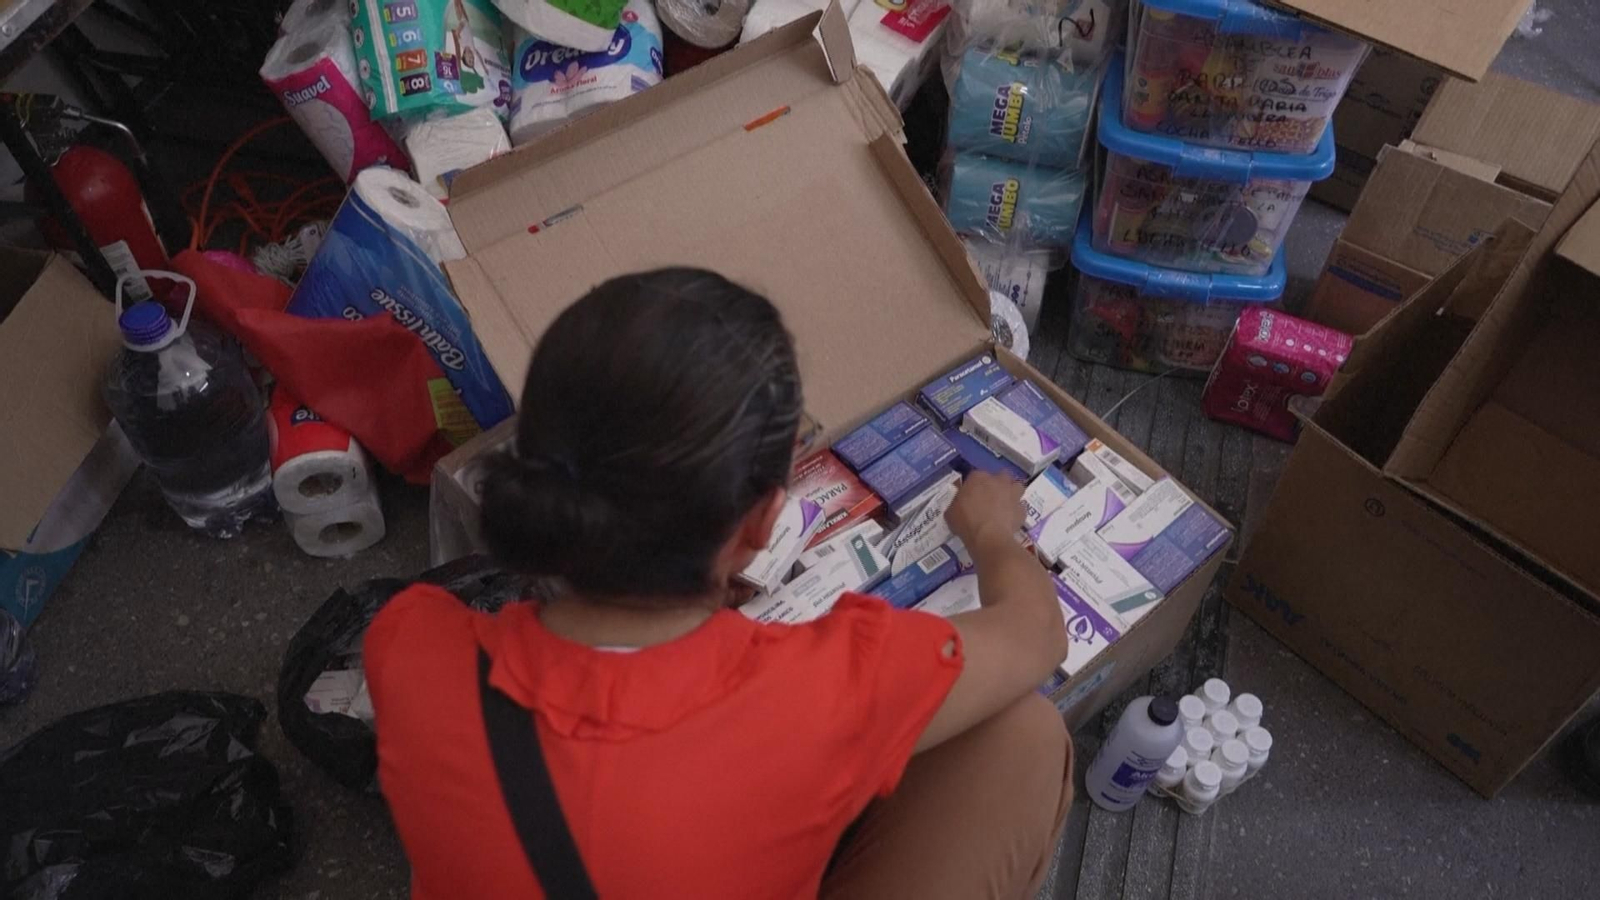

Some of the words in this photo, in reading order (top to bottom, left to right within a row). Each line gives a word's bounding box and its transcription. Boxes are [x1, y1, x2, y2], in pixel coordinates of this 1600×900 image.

[395, 6, 412, 17] 5
[402, 30, 417, 42] 6
[407, 54, 421, 65] 7
[525, 39, 625, 71] Dreay
[283, 75, 332, 106] Suavel
[410, 77, 425, 90] 8
[990, 85, 1011, 136] MEGA
[1002, 82, 1028, 143] JUMBO
[998, 178, 1020, 229] UMBO
[949, 360, 983, 382] Paracetamol
